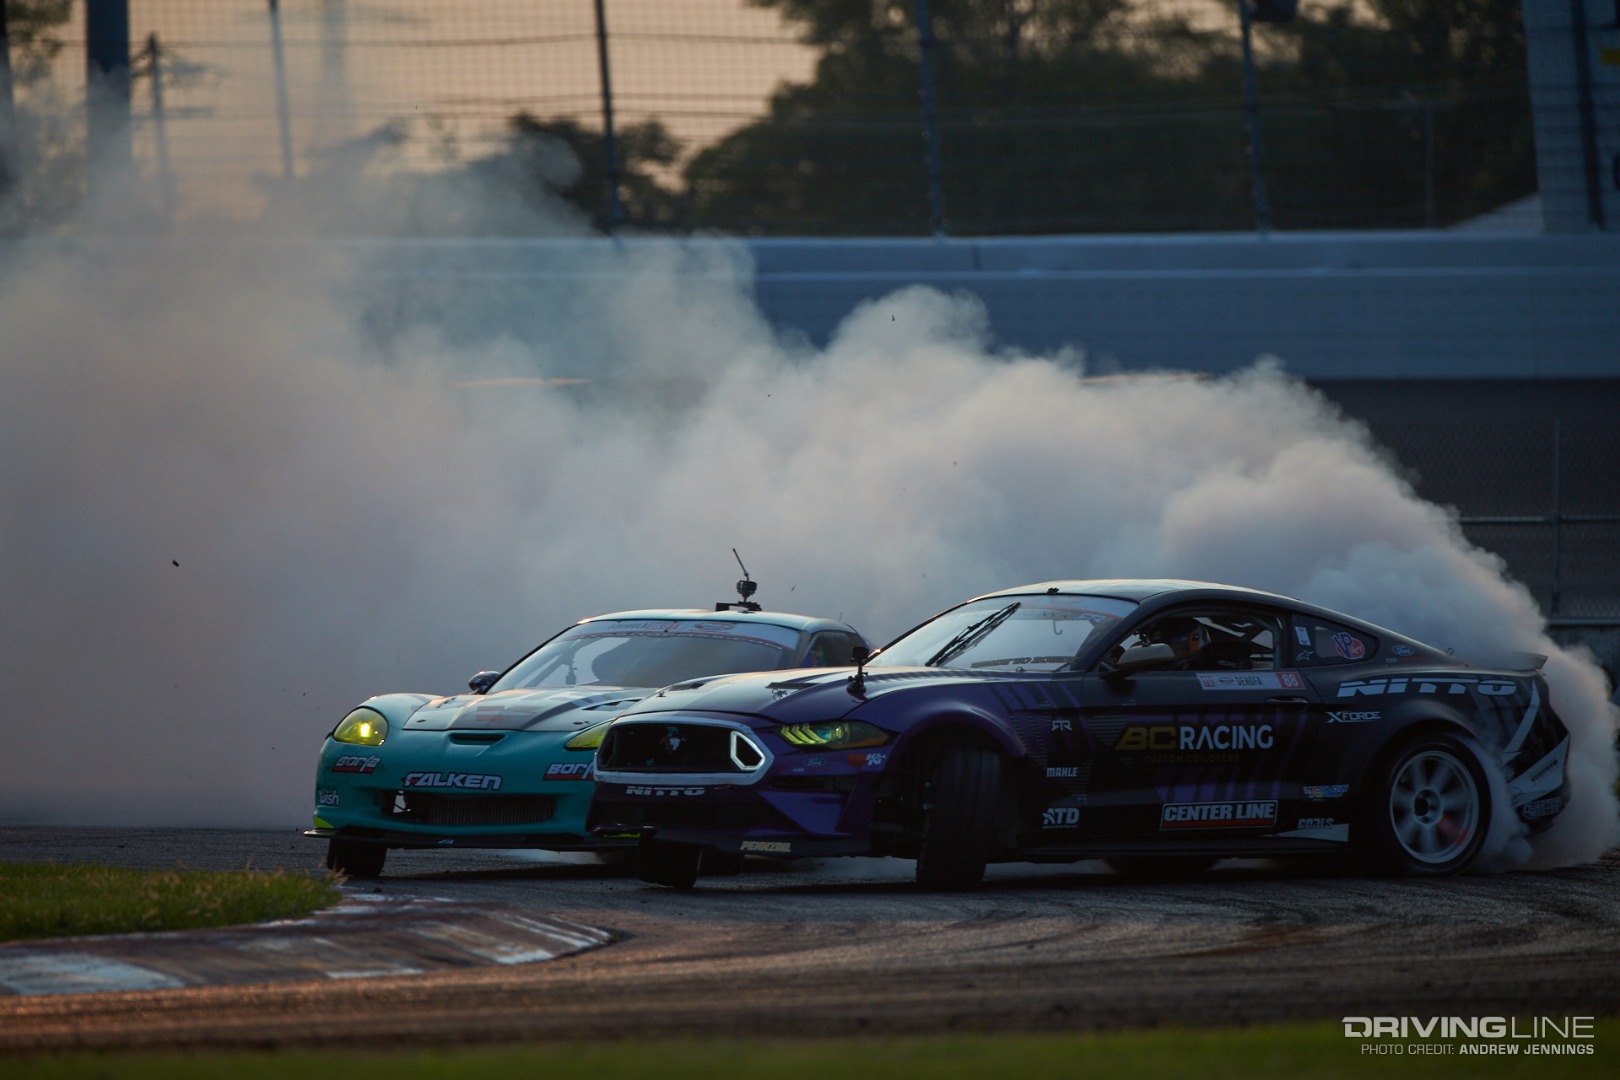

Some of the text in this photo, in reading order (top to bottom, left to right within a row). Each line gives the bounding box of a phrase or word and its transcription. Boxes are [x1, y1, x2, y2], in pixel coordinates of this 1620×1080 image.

[1281, 673, 1299, 688] 88
[1336, 677, 1518, 698] NITTO
[1113, 724, 1275, 751] BC RACING
[1046, 767, 1079, 778] MAHLE
[403, 772, 502, 790] FALKEN
[625, 785, 706, 796] NITTO
[1163, 802, 1276, 822] CENTER LINE
[739, 840, 792, 853] PENNZOIL
